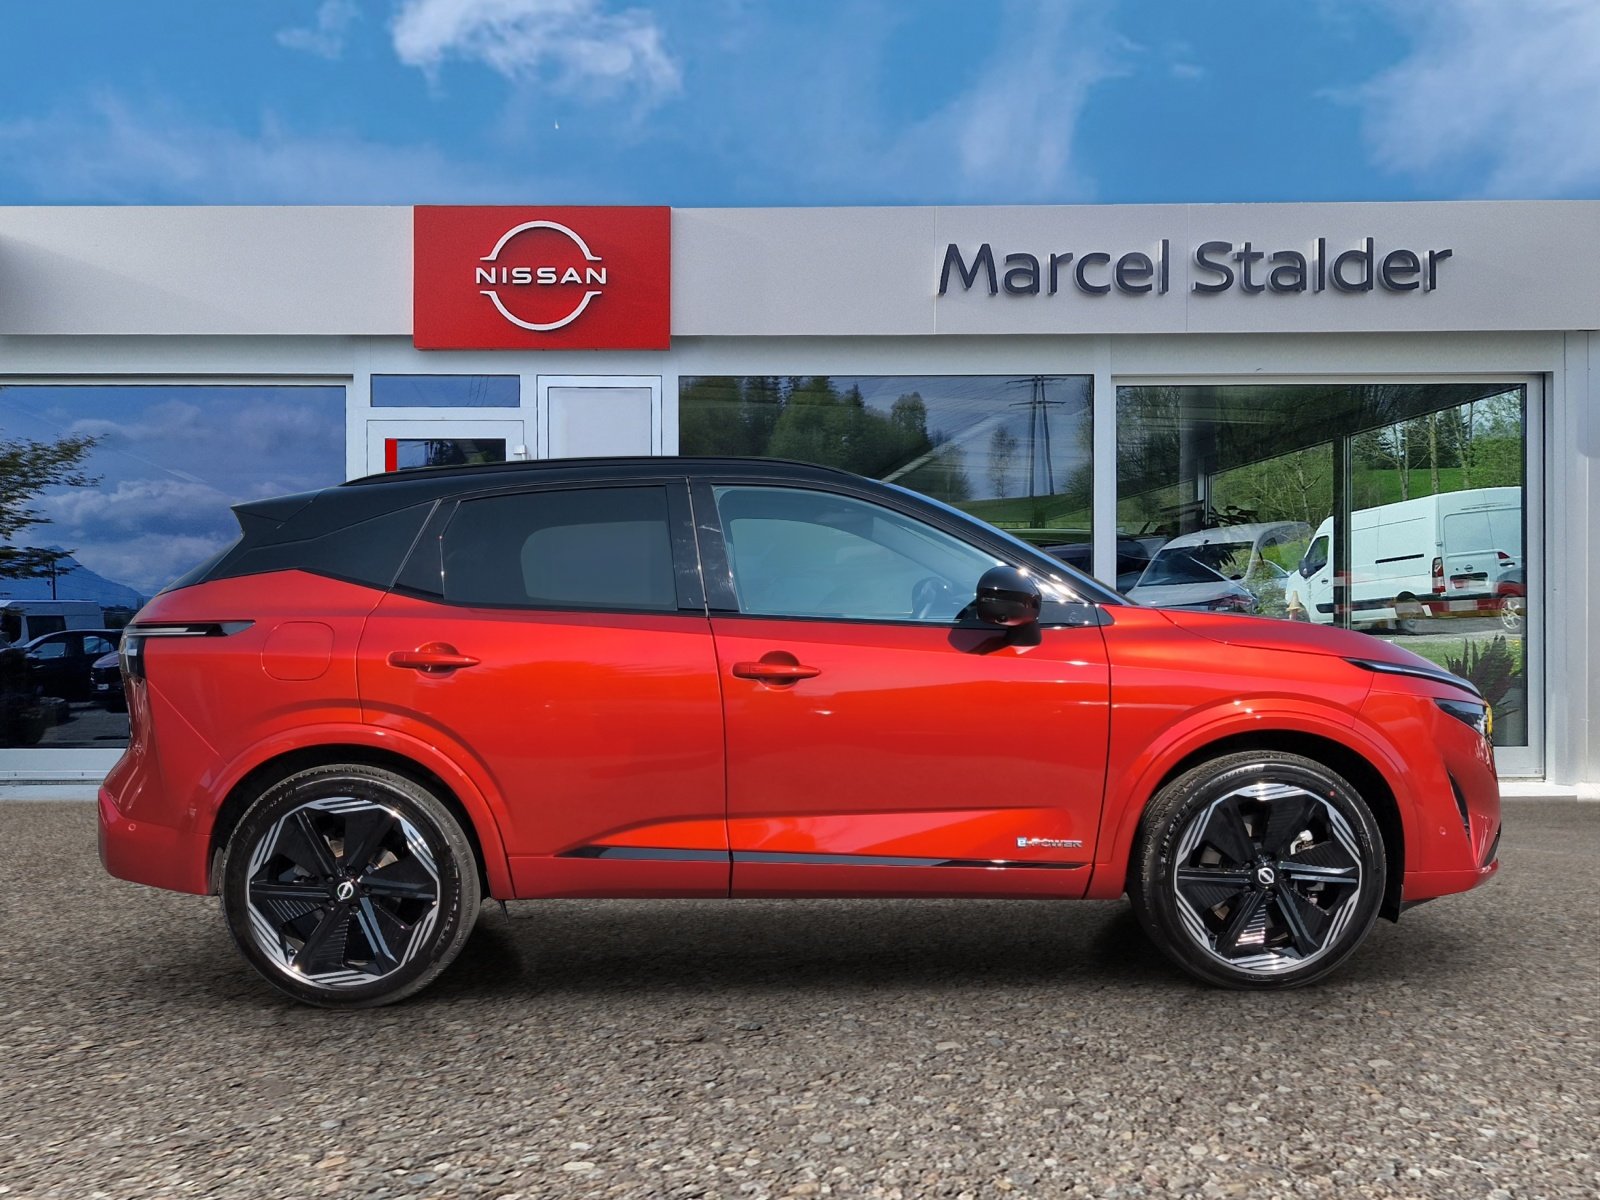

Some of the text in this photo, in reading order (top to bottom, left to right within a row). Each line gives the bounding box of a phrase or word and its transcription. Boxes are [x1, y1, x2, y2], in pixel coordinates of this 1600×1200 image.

[475, 267, 607, 285] NISSAN
[939, 237, 1453, 297] Marcel Stalder
